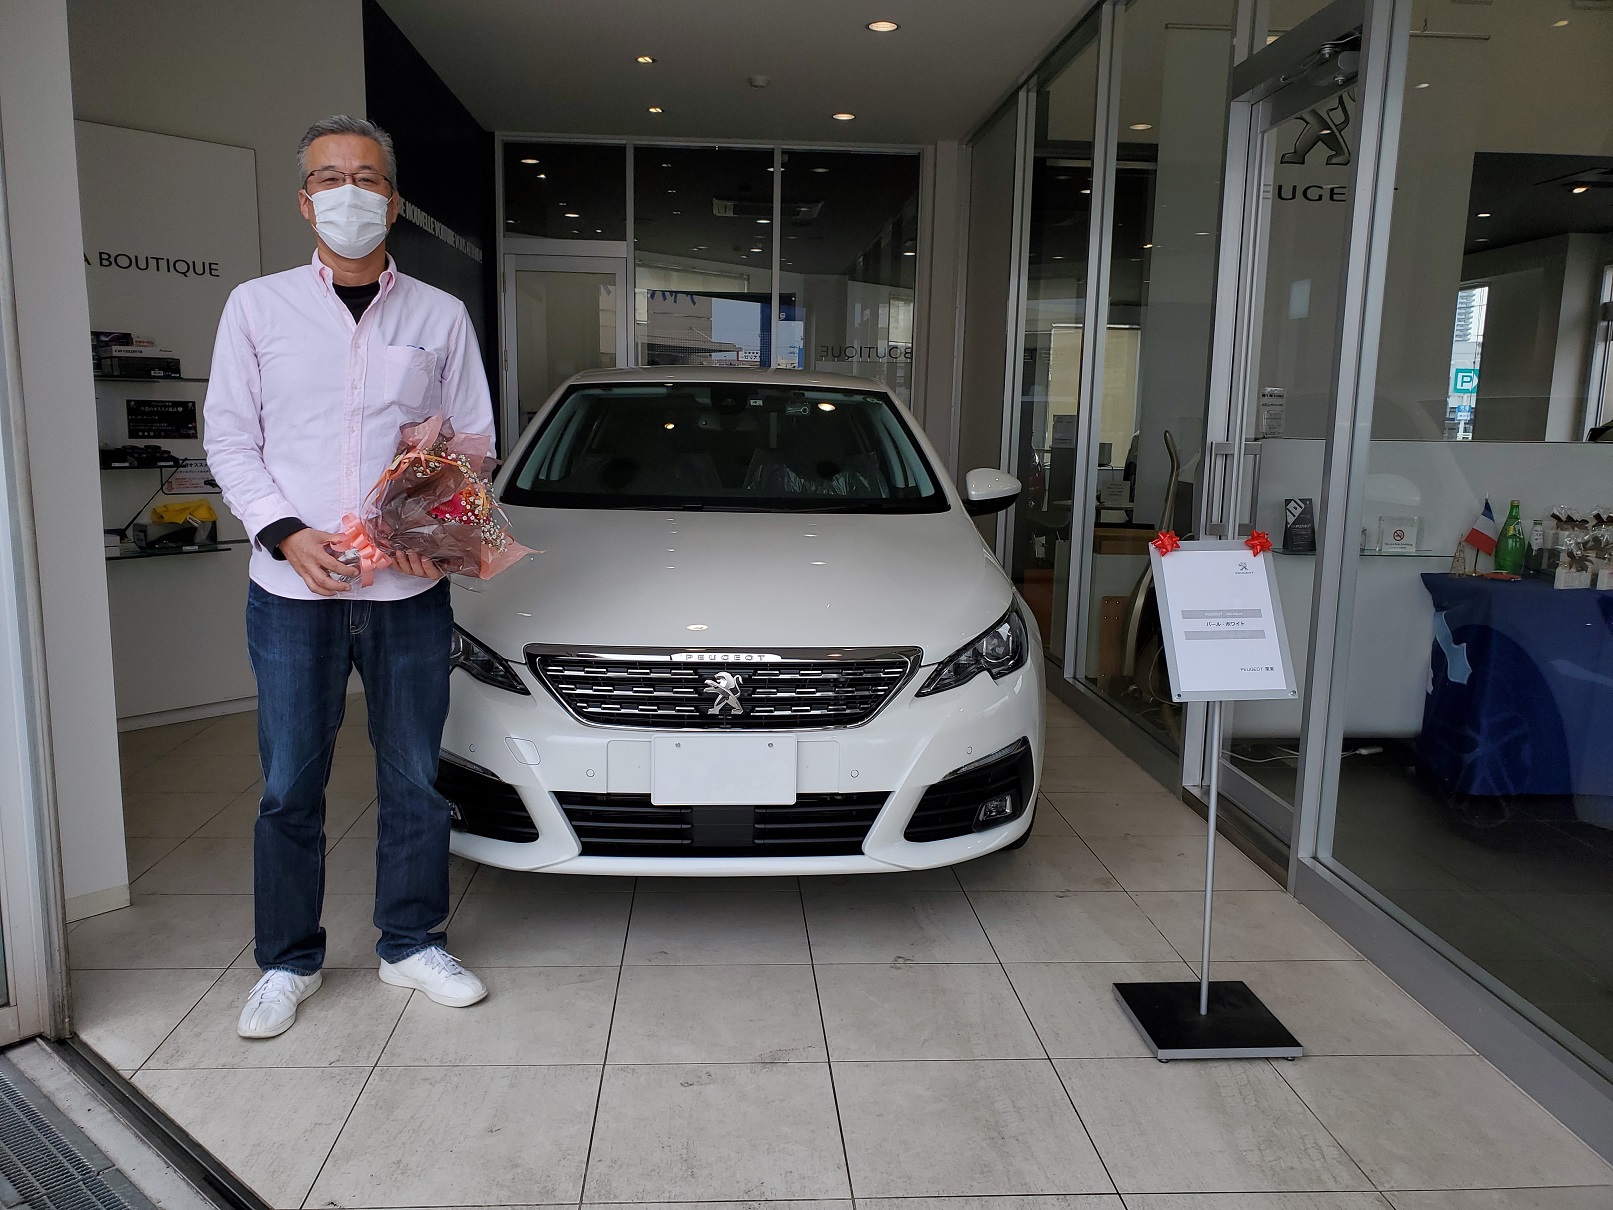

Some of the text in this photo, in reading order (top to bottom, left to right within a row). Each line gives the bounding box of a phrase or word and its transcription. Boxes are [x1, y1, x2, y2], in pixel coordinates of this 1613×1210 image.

[98, 251, 220, 280] BOUTIQUE
[1460, 374, 1473, 388] P
[686, 654, 766, 662] PEUGEOT
